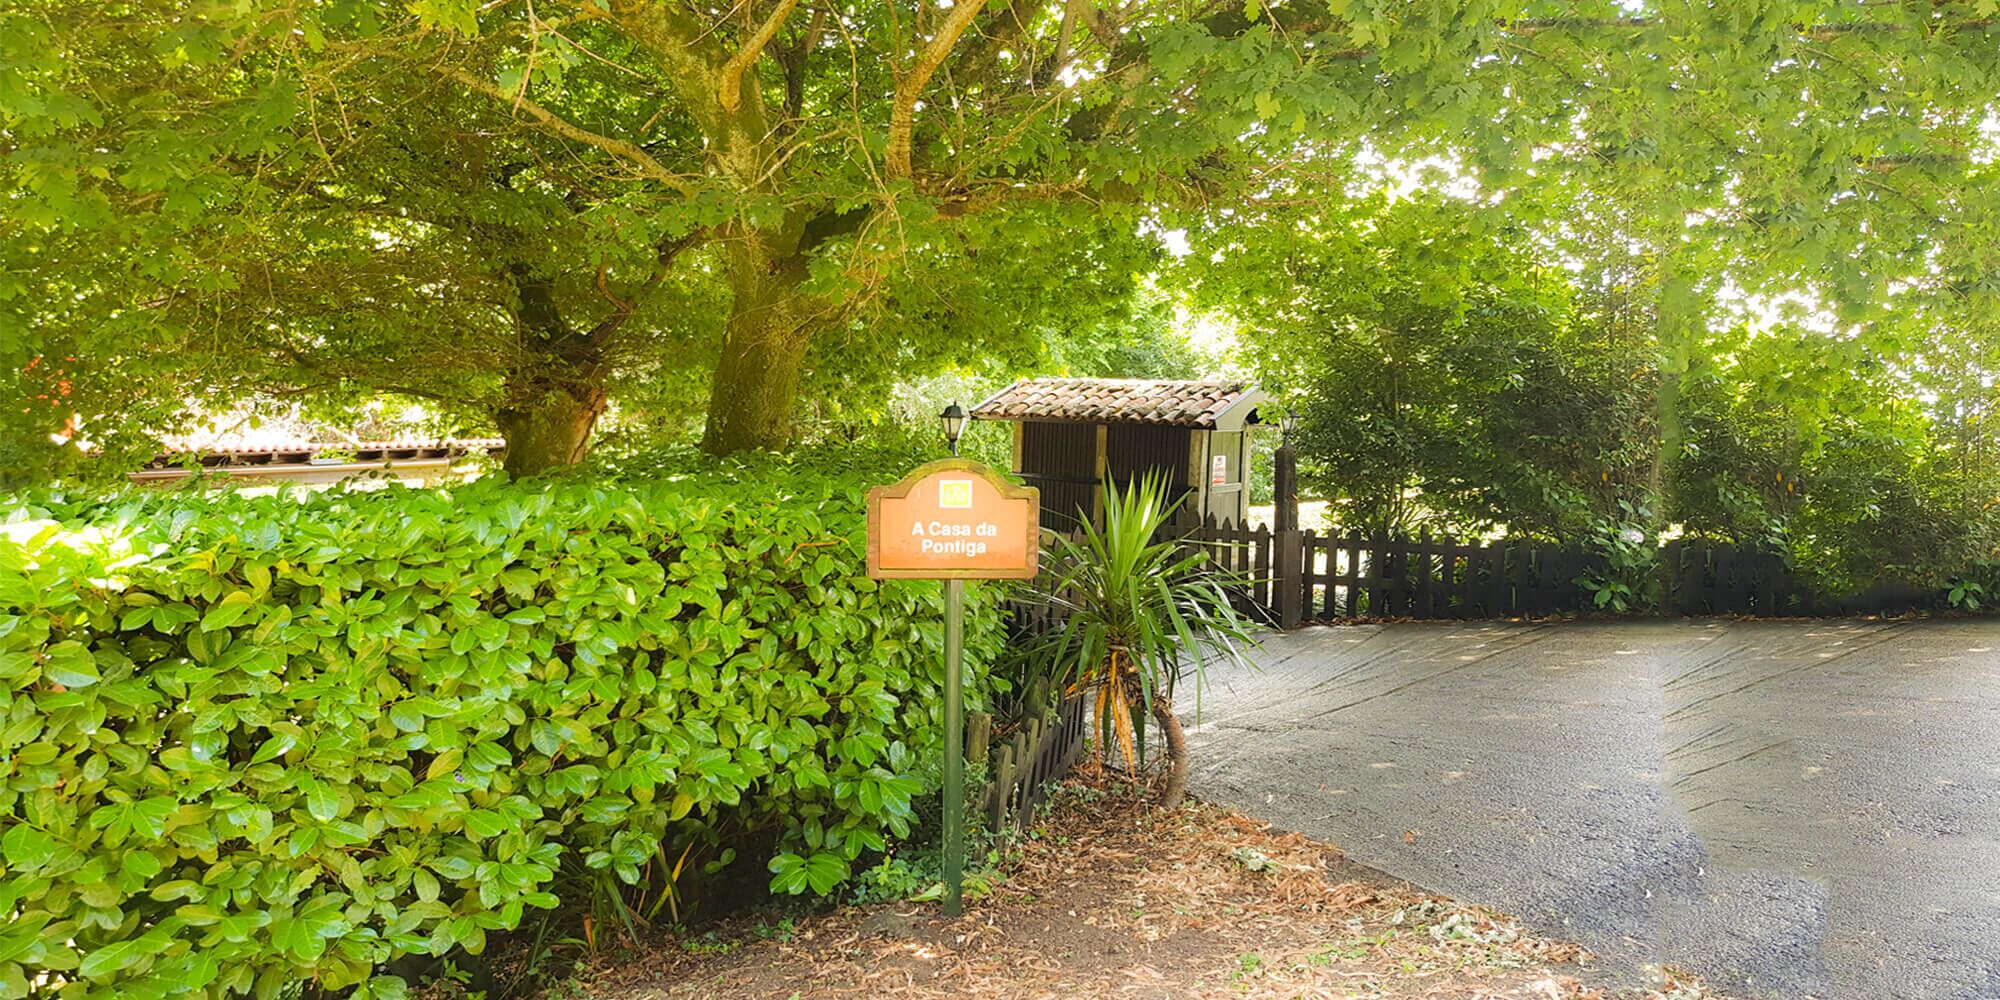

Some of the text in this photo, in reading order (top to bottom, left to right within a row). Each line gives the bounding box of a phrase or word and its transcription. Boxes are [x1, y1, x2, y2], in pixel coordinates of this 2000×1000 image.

[911, 521, 997, 537] A Casa da
[921, 539, 987, 557] Pontiga
